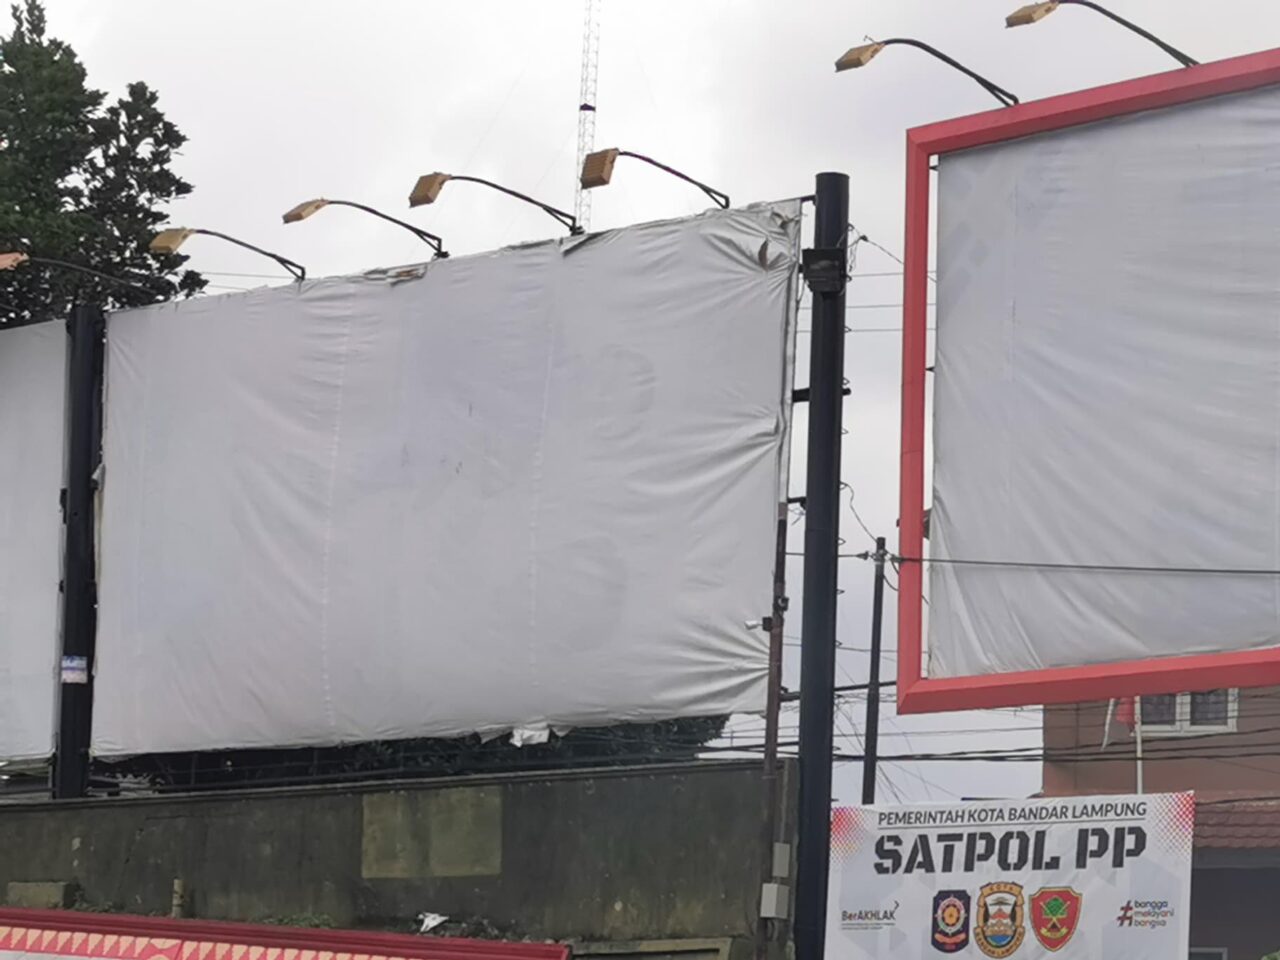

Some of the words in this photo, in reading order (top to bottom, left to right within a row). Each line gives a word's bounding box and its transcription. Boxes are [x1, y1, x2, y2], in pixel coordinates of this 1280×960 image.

[878, 810, 964, 825] PEMERINTAH
[967, 808, 1005, 823] KOTA
[1008, 805, 1068, 821] BANDAR
[1072, 802, 1147, 819] LAMPUNG
[874, 831, 1060, 874] SATPOL
[1076, 826, 1147, 869] PP
